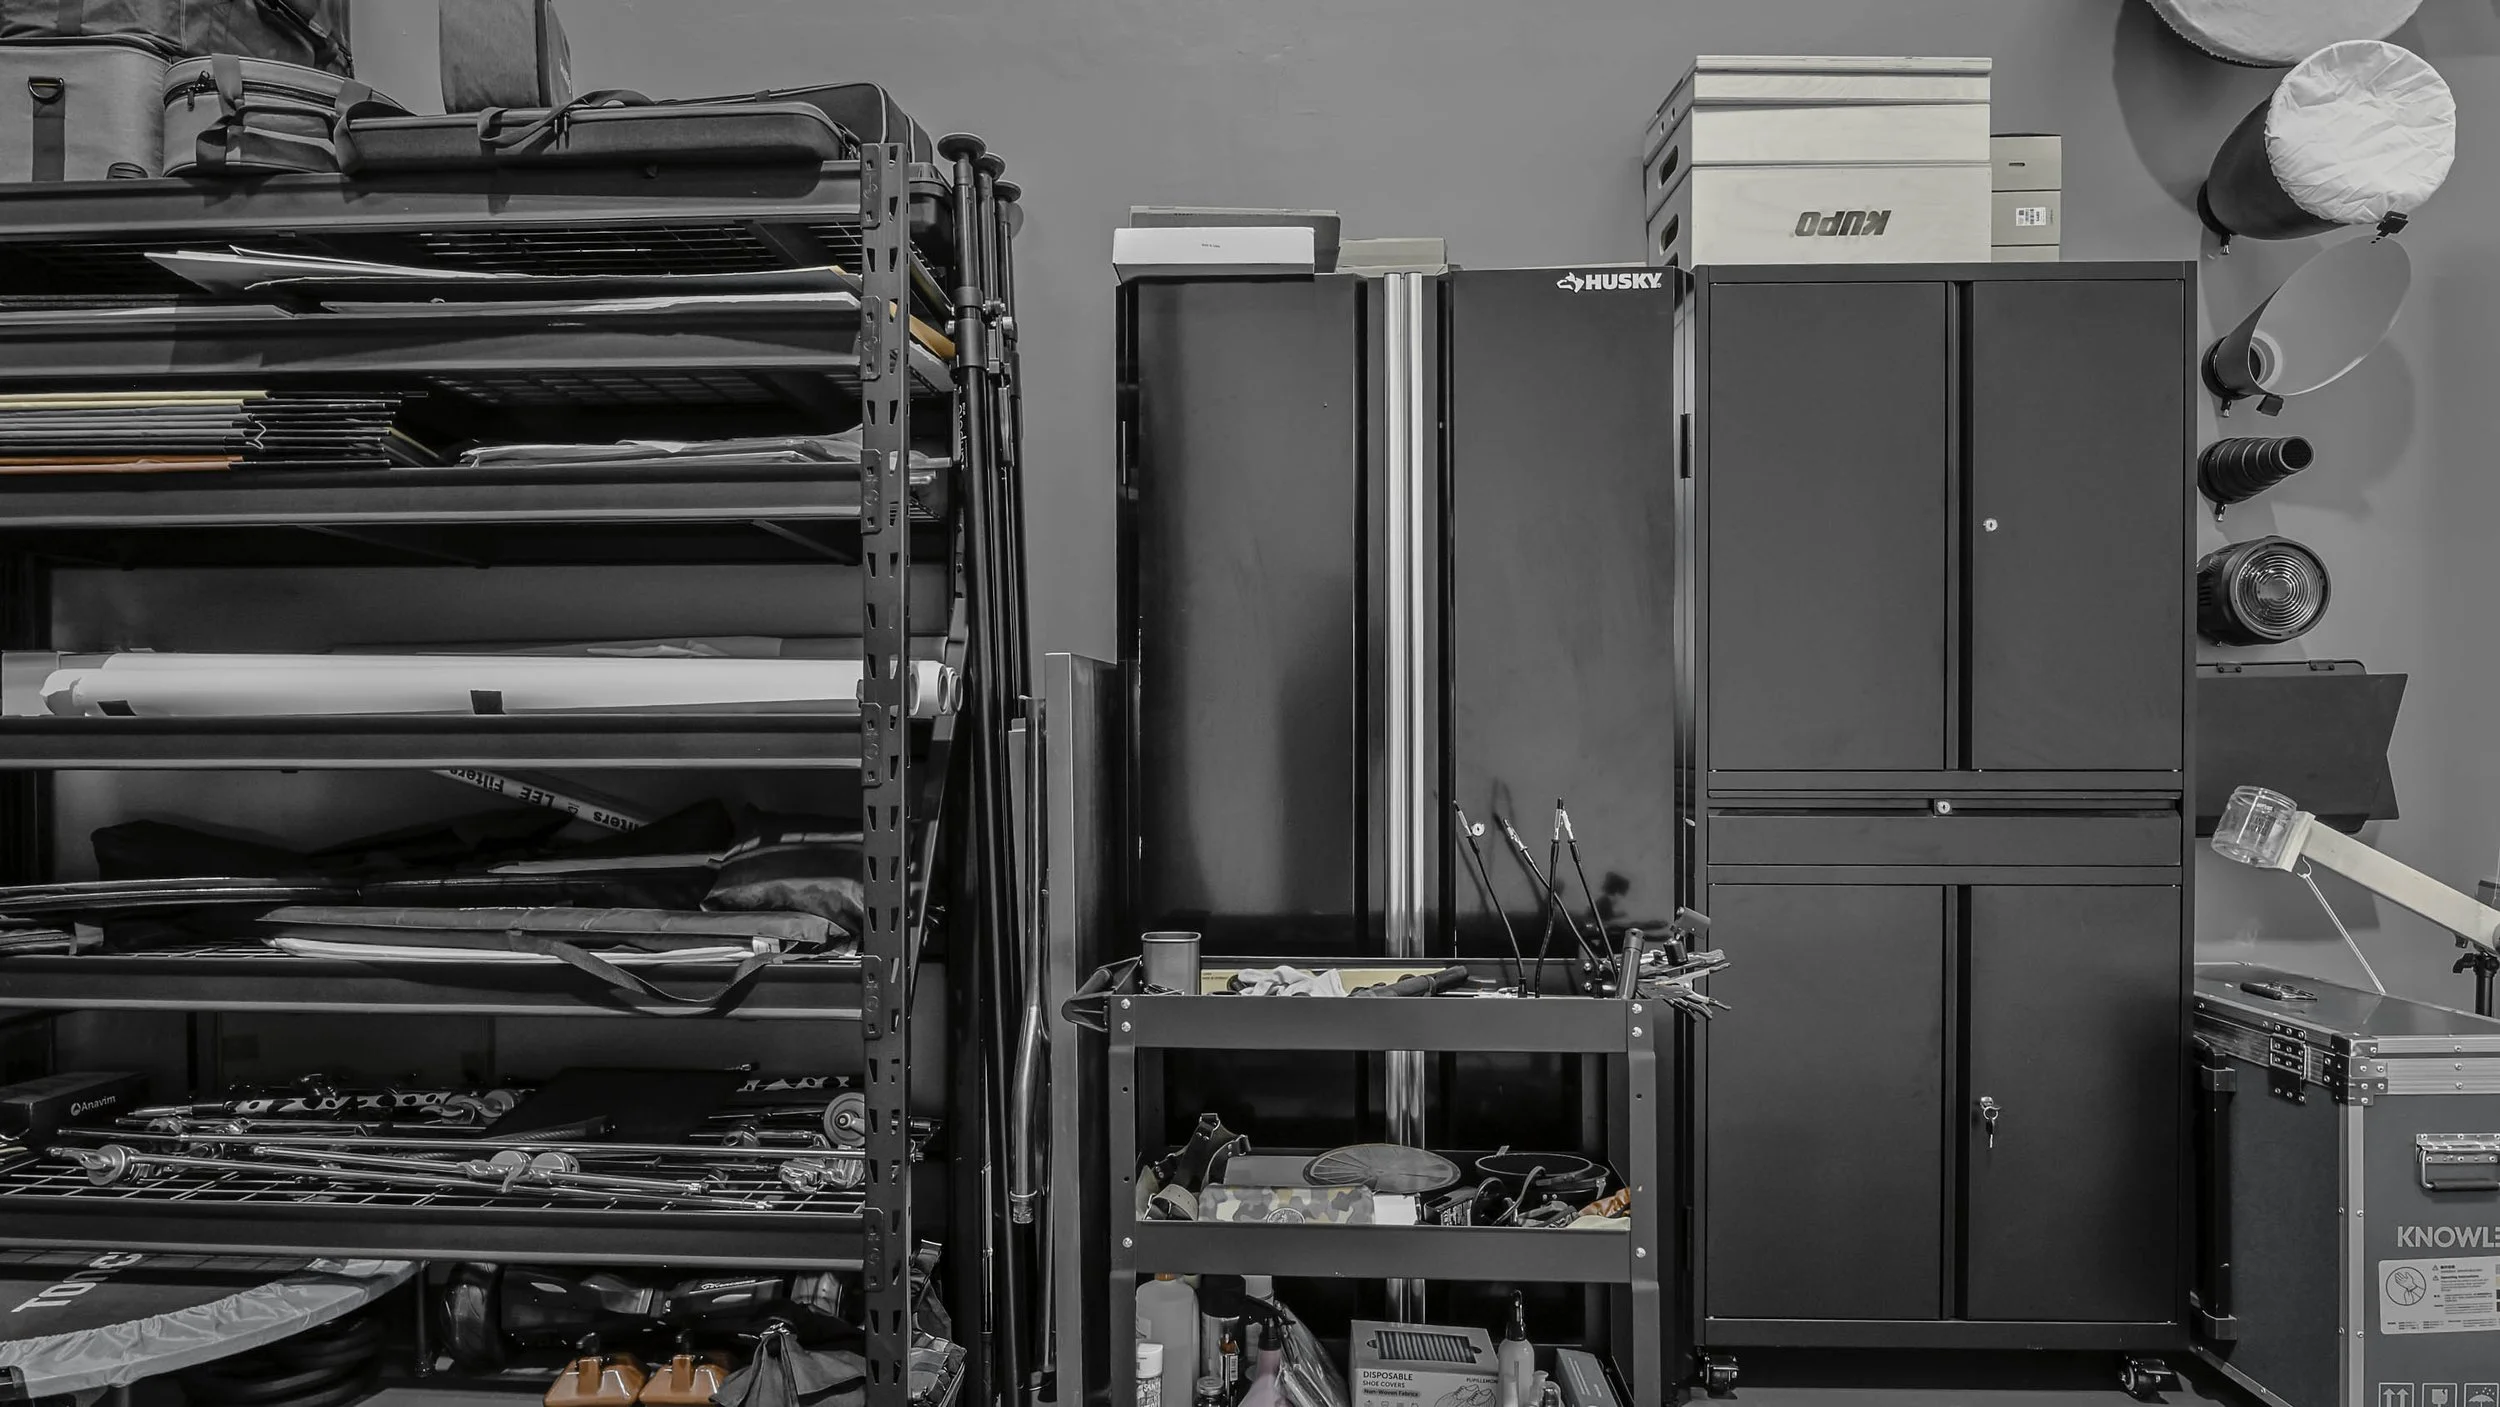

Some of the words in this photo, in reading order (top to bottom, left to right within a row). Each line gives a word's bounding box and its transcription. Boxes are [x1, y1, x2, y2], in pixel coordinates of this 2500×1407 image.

[1795, 210, 1892, 236] KUPO
[1585, 273, 1662, 290] HUSKY
[519, 786, 555, 808] LEE
[81, 1095, 116, 1111] Anavim
[1363, 1371, 1413, 1381] DISPOSABLE
